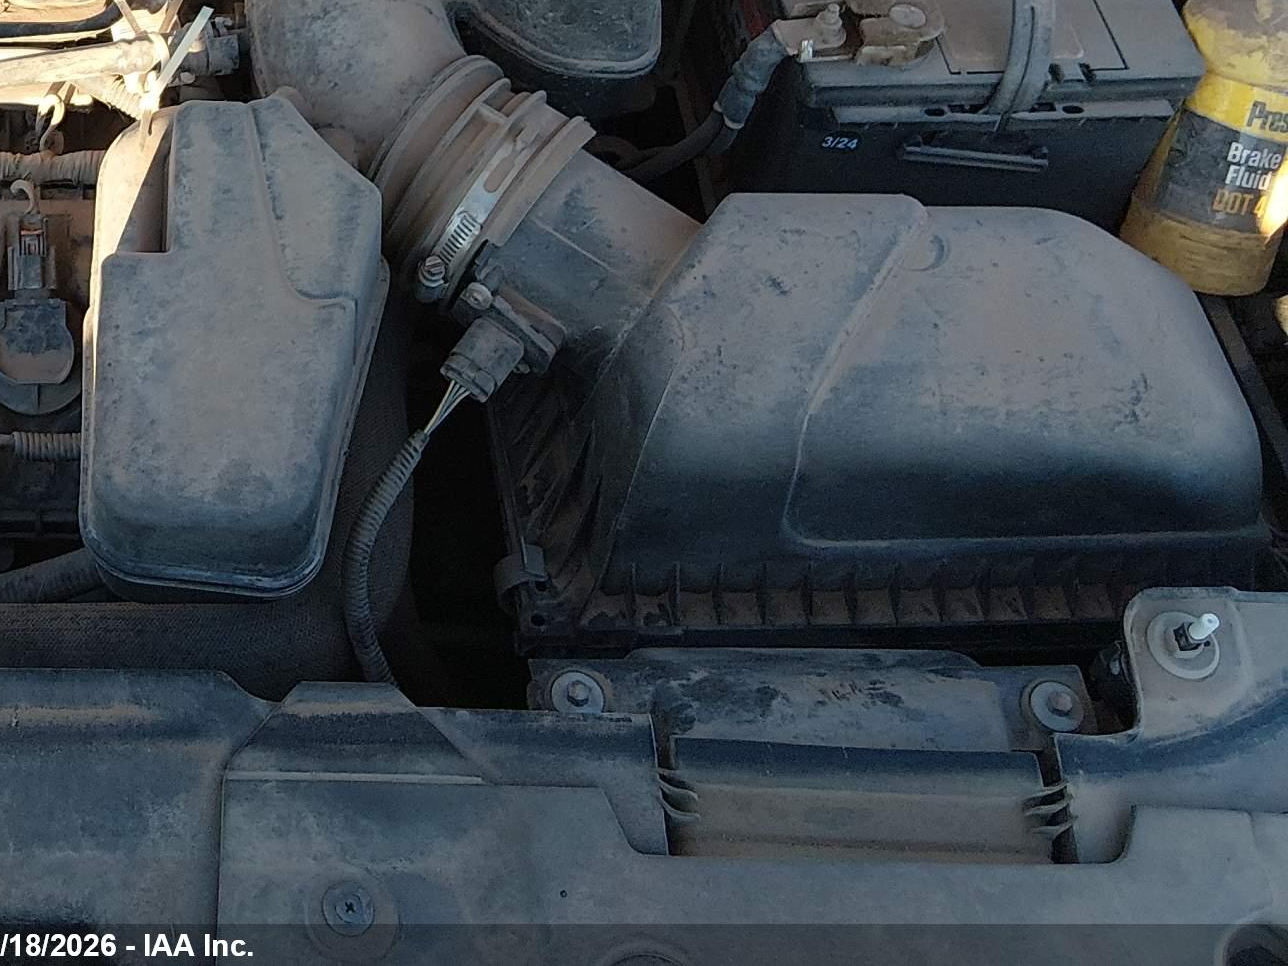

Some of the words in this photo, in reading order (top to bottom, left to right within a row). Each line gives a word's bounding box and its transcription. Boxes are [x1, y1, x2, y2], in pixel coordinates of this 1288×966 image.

[821, 136, 859, 150] 3/24
[1227, 142, 1282, 169] Brake
[1224, 164, 1273, 190] Fluid
[1212, 188, 1253, 216] DOT
